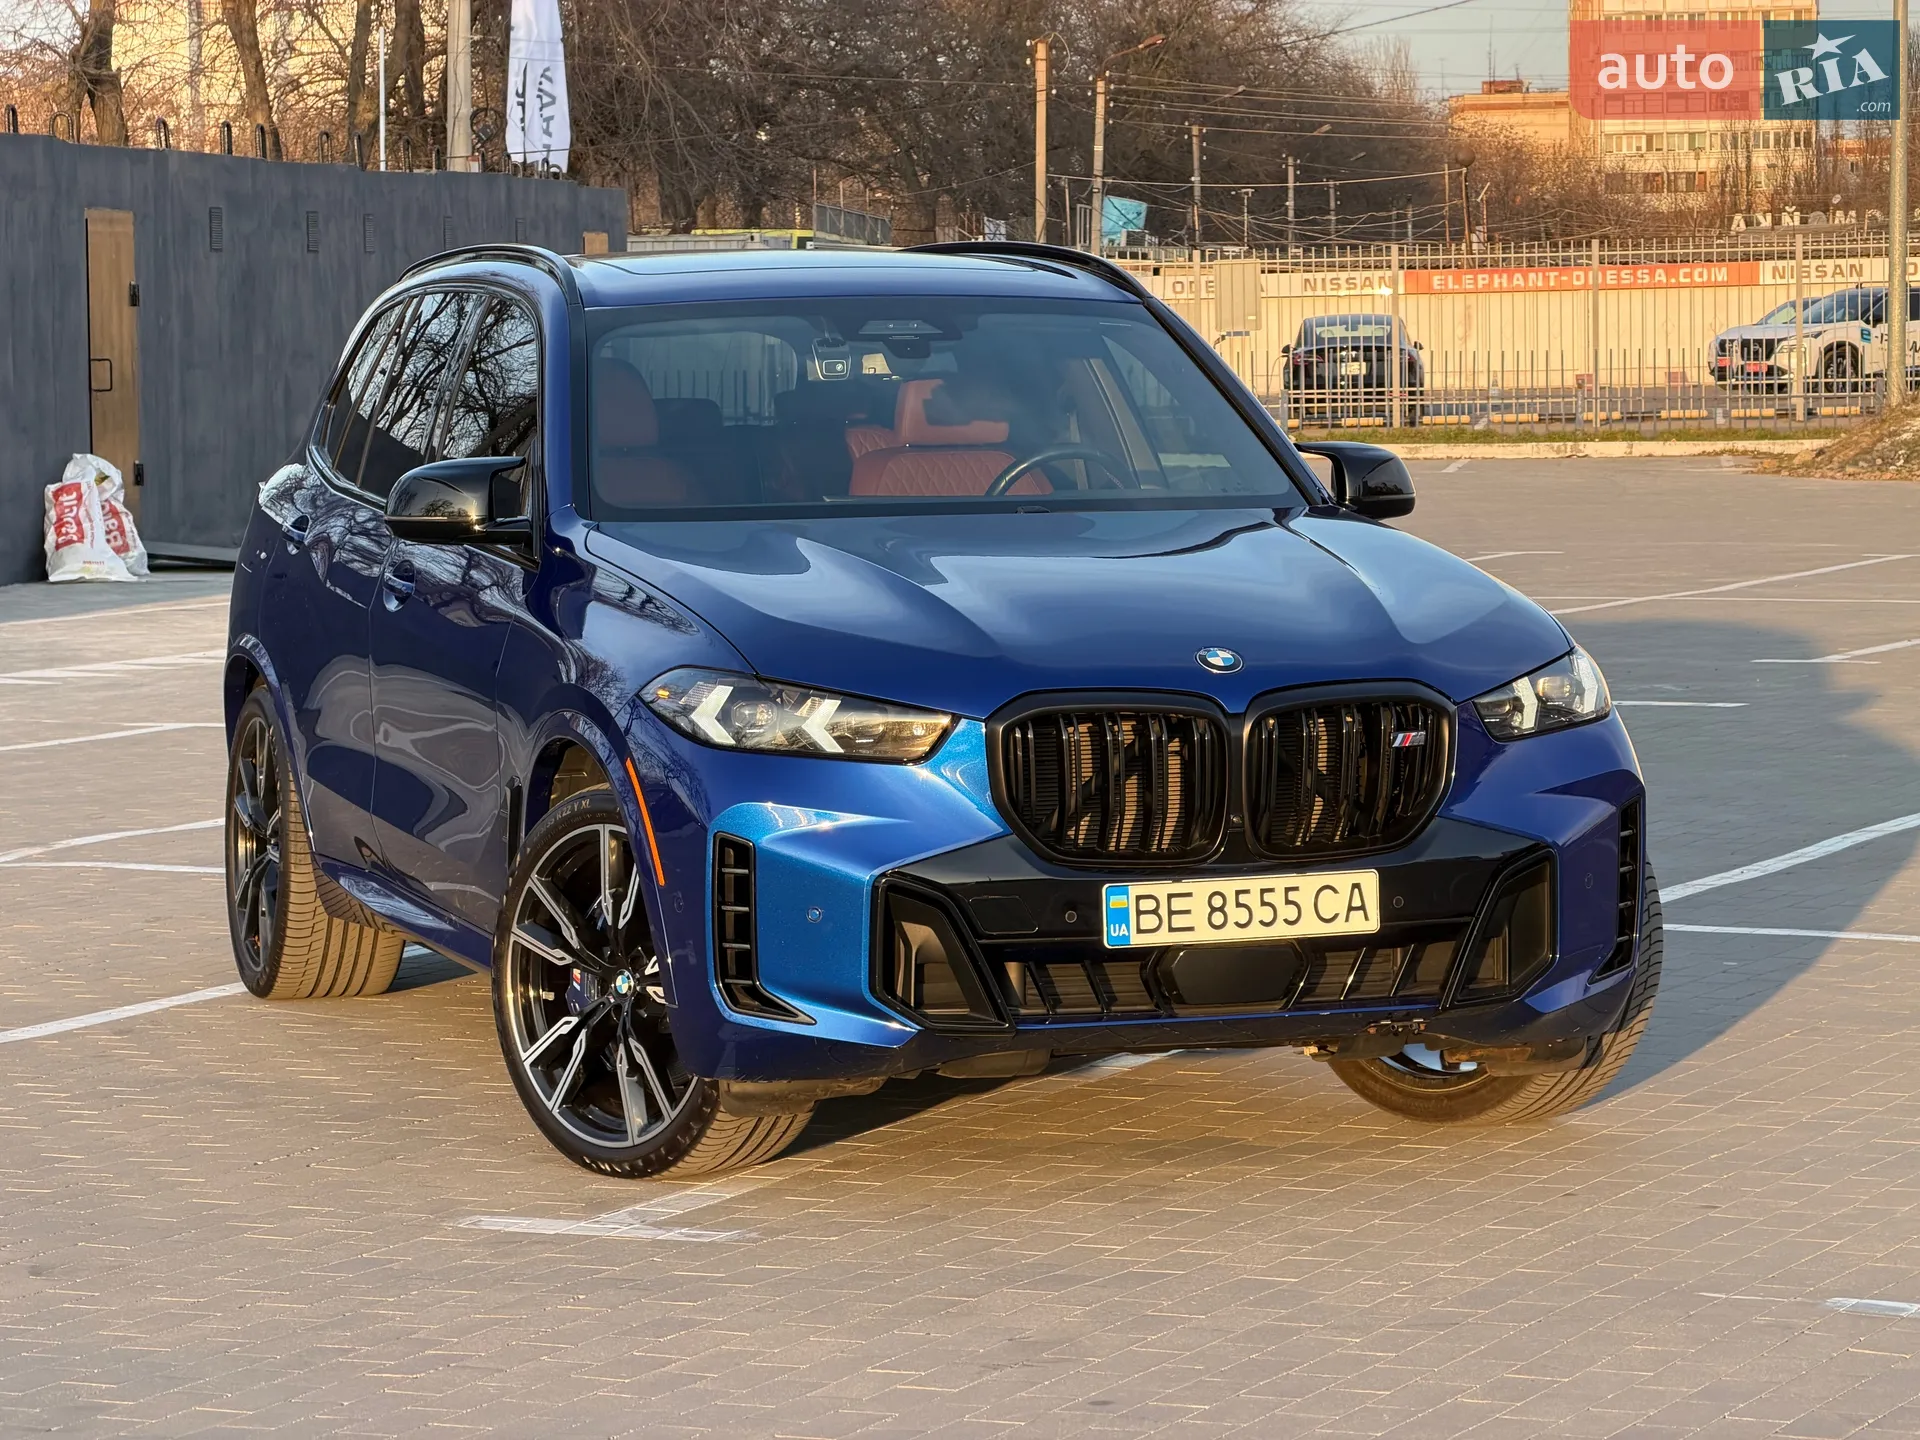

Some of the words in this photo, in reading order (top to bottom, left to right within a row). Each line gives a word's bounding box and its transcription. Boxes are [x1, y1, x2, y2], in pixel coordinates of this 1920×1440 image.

[1432, 266, 1729, 290] ELEPHANT-ODESSA.COM
[1772, 263, 1864, 280] NISSAN
[1303, 275, 1393, 292] NISSAN
[1135, 892, 1196, 935] BE
[1207, 886, 1302, 931] 8555
[1313, 882, 1371, 924] CA
[1110, 922, 1130, 938] UA
